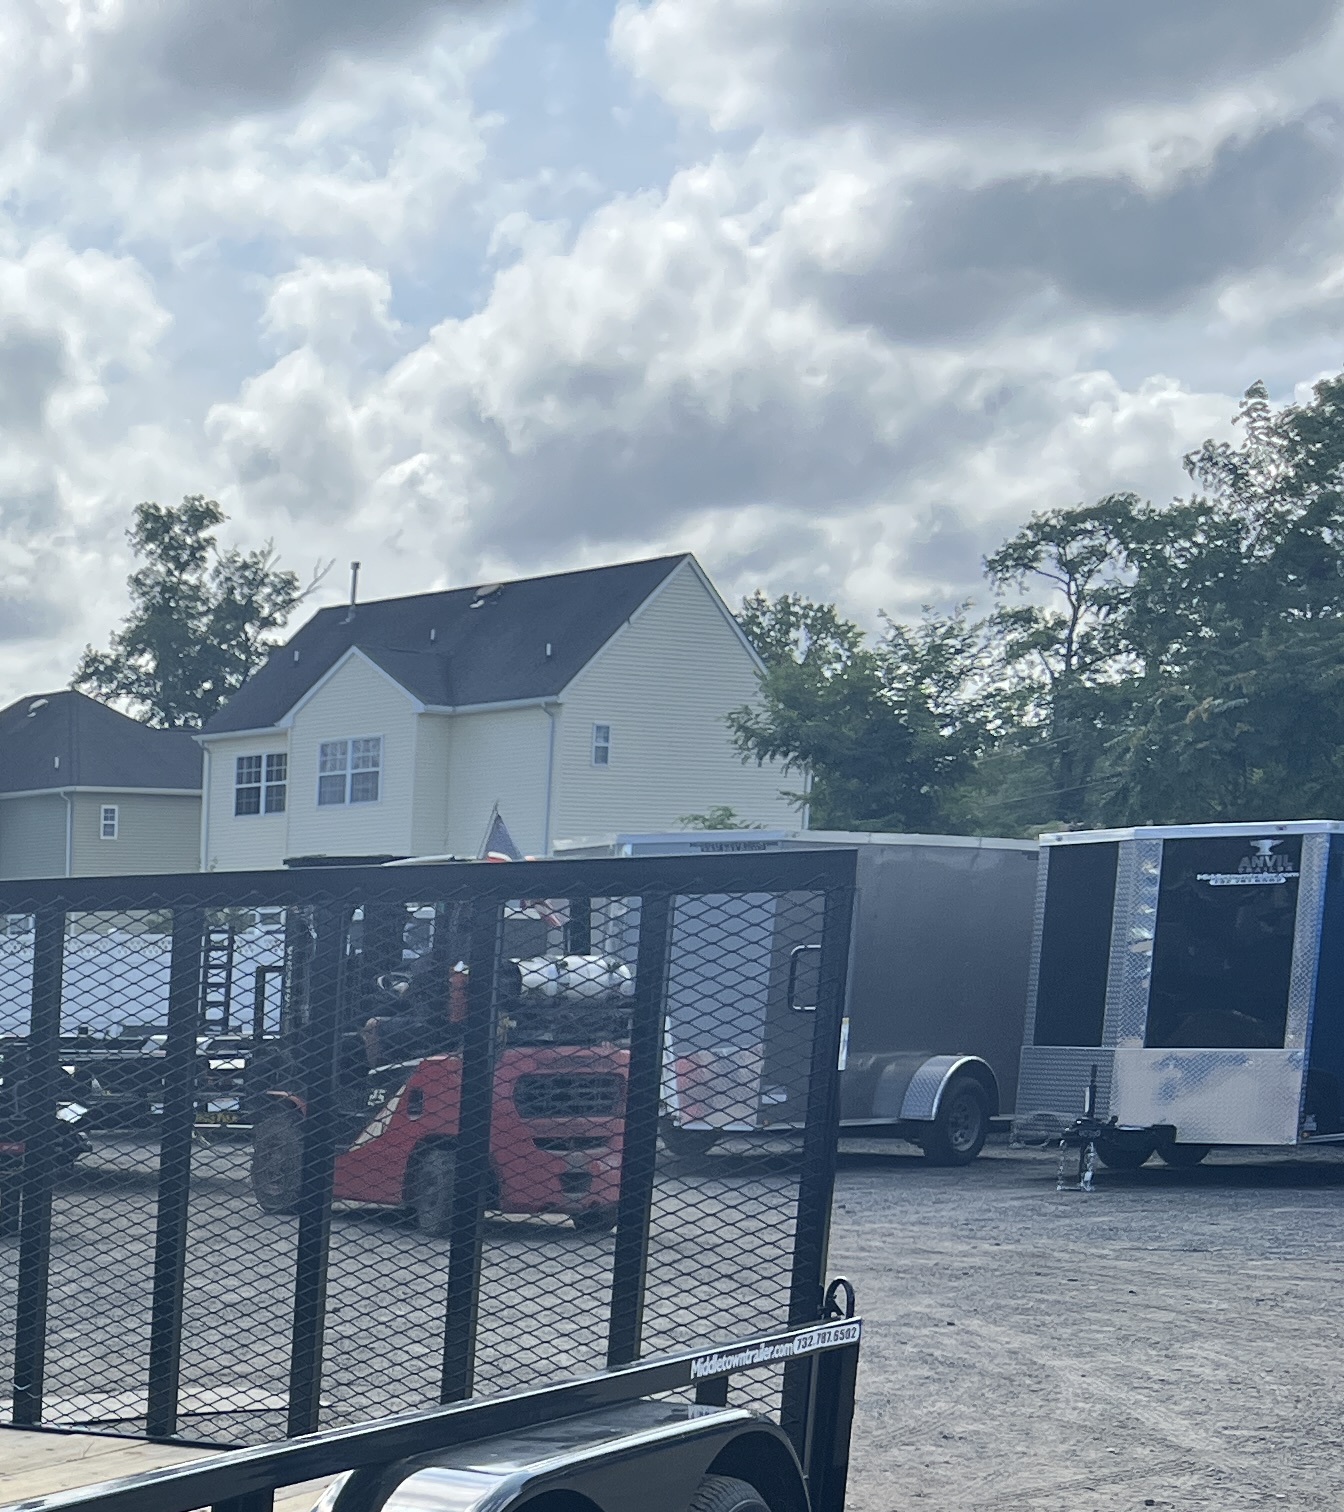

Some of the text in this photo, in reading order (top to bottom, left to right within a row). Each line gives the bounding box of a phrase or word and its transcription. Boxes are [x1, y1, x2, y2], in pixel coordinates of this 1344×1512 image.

[1238, 853, 1293, 868] ANVIL
[690, 1326, 858, 1380] Middletowntrailer.com 732.787.6502
